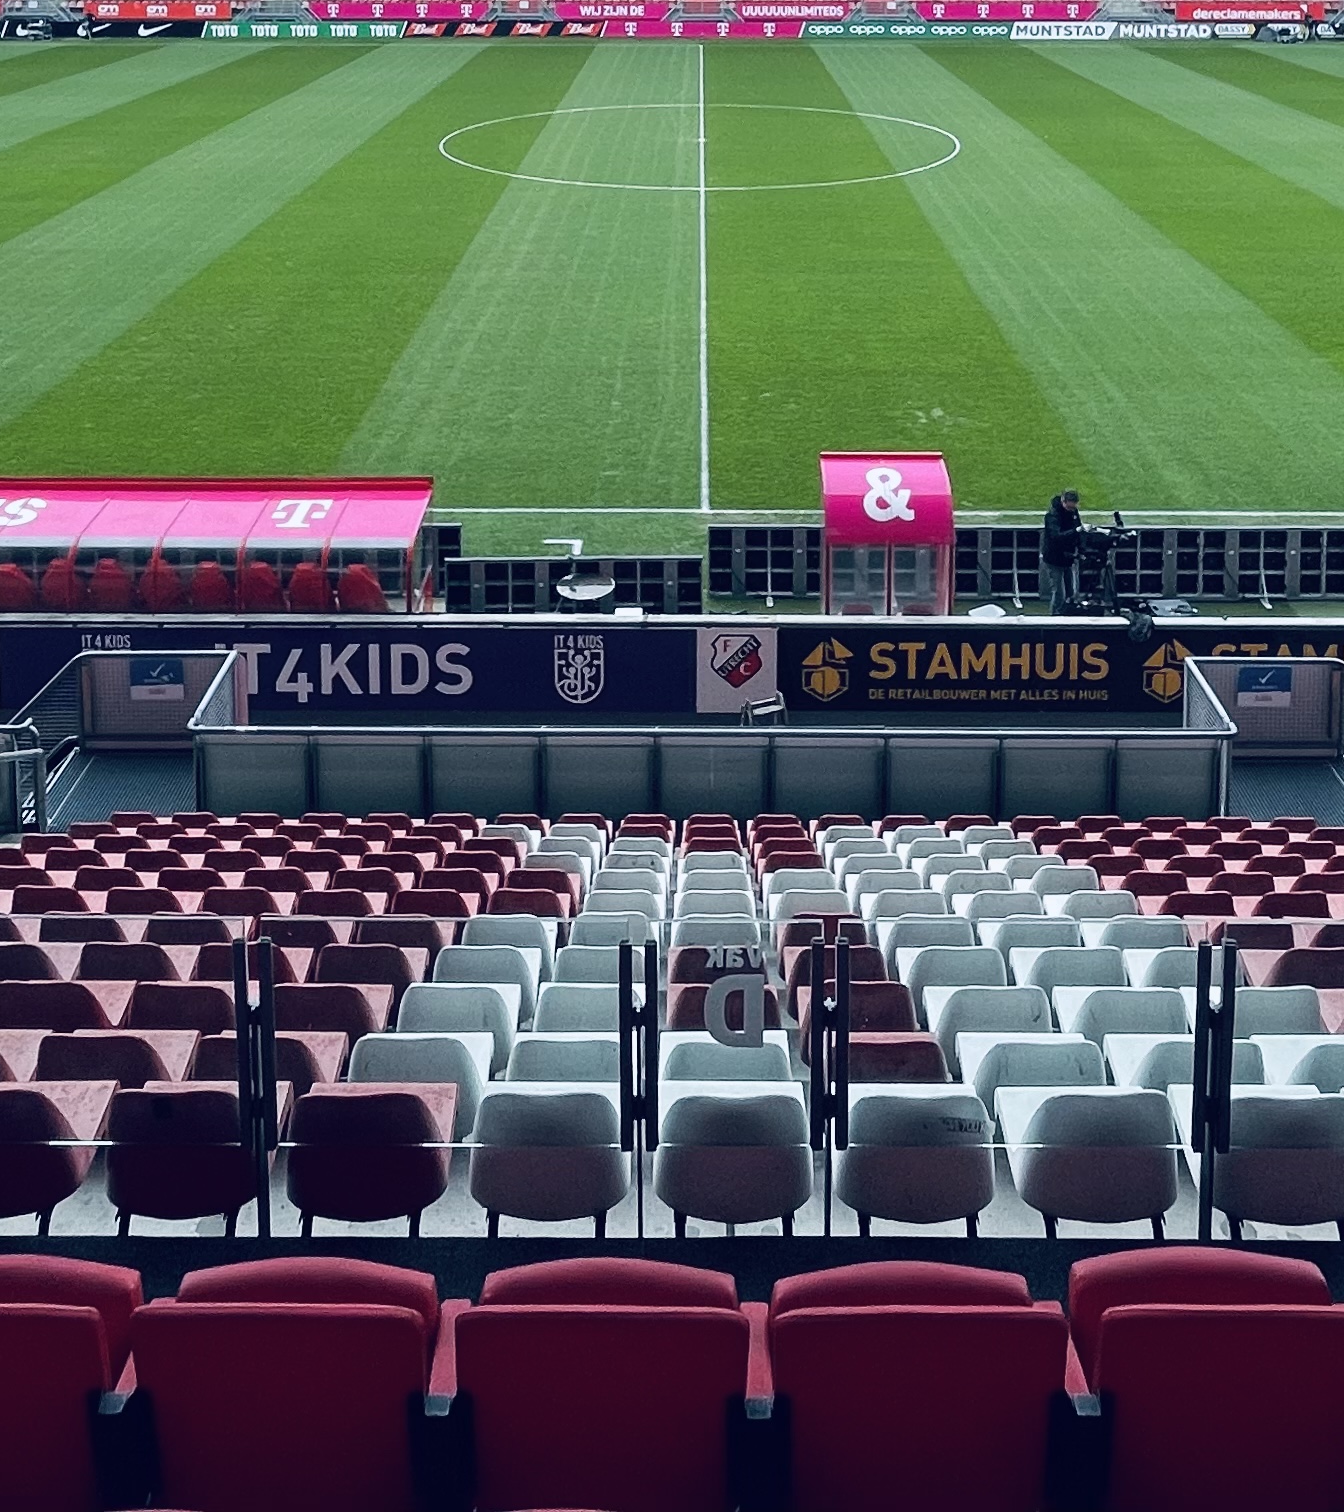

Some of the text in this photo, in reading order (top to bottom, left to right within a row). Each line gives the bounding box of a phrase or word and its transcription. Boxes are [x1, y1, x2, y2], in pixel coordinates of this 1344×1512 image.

[327, 3, 339, 17] T
[371, 3, 384, 17] T
[416, 3, 428, 17] T
[460, 3, 472, 17] T
[580, 5, 644, 16] WIJ ZIJN DE
[932, 3, 945, 18] T
[977, 3, 989, 18] T
[1022, 3, 1034, 18] T
[1067, 3, 1079, 18] T
[1193, 8, 1301, 20] dereclamemakers
[210, 24, 238, 37] TOTO
[251, 24, 279, 37] TOTO
[290, 24, 317, 37] TOTO
[330, 24, 358, 37] TOTO
[370, 24, 397, 37] TOTO
[413, 22, 437, 35] Bud
[463, 22, 486, 35] Bud
[519, 22, 542, 35] Bud
[570, 22, 594, 35] Bud
[625, 22, 637, 36] T
[671, 22, 683, 36] T
[717, 22, 729, 36] T
[763, 22, 776, 36] T
[808, 25, 844, 35] oppo
[849, 25, 885, 35] oppo
[890, 25, 926, 35] oppo
[931, 25, 967, 36] oppo
[972, 25, 1008, 36] oppo
[1016, 25, 1106, 37] MUNTSTAD
[1119, 24, 1212, 38] MUNTSTAD
[863, 467, 915, 522] &
[81, 634, 131, 648] IT 4 KIDS
[554, 635, 603, 649] IT 4 KIDS
[723, 639, 731, 653] F
[869, 642, 1109, 680] STAMHUIS
[215, 643, 473, 702] T4KIDS
[740, 662, 752, 676] C
[869, 689, 1109, 700] DE RETAILBOUWER MET ALLES IN HUIS
